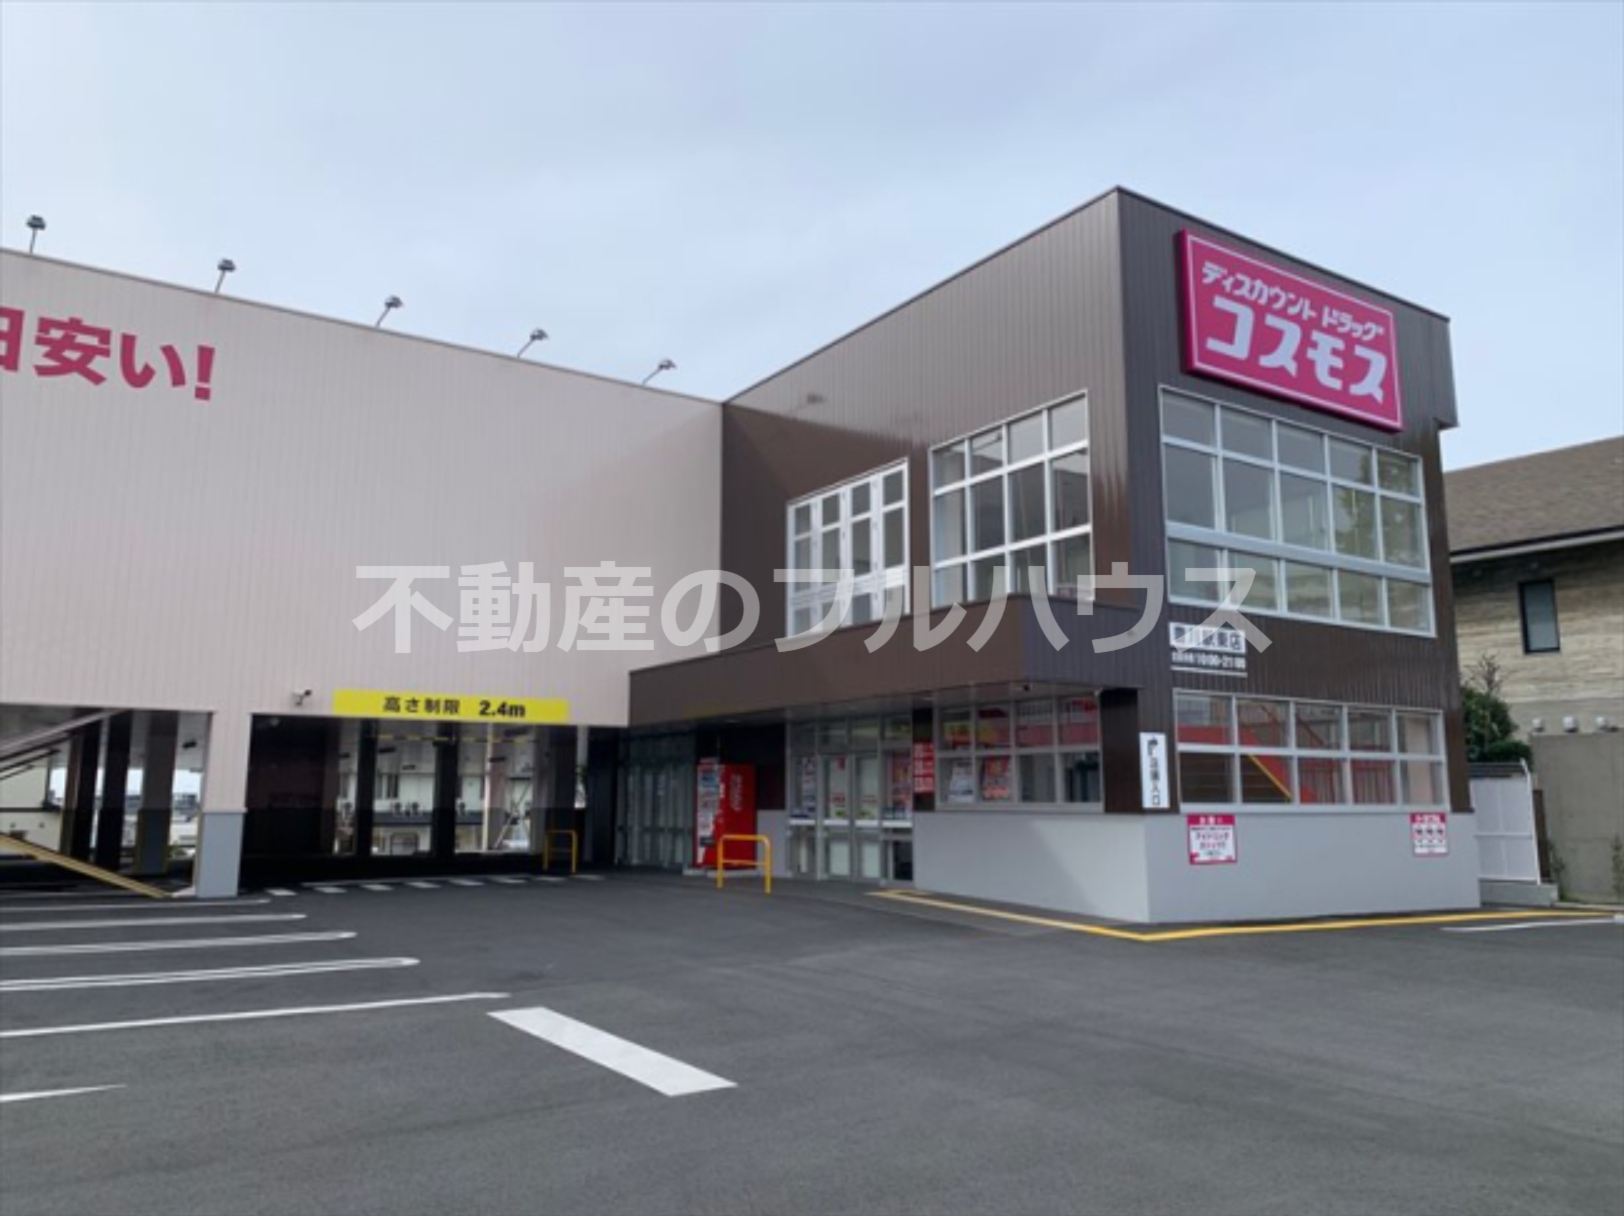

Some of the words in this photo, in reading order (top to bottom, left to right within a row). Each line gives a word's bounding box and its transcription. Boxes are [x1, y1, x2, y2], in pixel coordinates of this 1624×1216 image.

[1202, 261, 1317, 320] ディスカウント
[1321, 305, 1385, 341] ドラッグ
[1205, 295, 1387, 404] コスモス
[383, 696, 460, 715] 高さ制限
[478, 700, 525, 717] 2.4m
